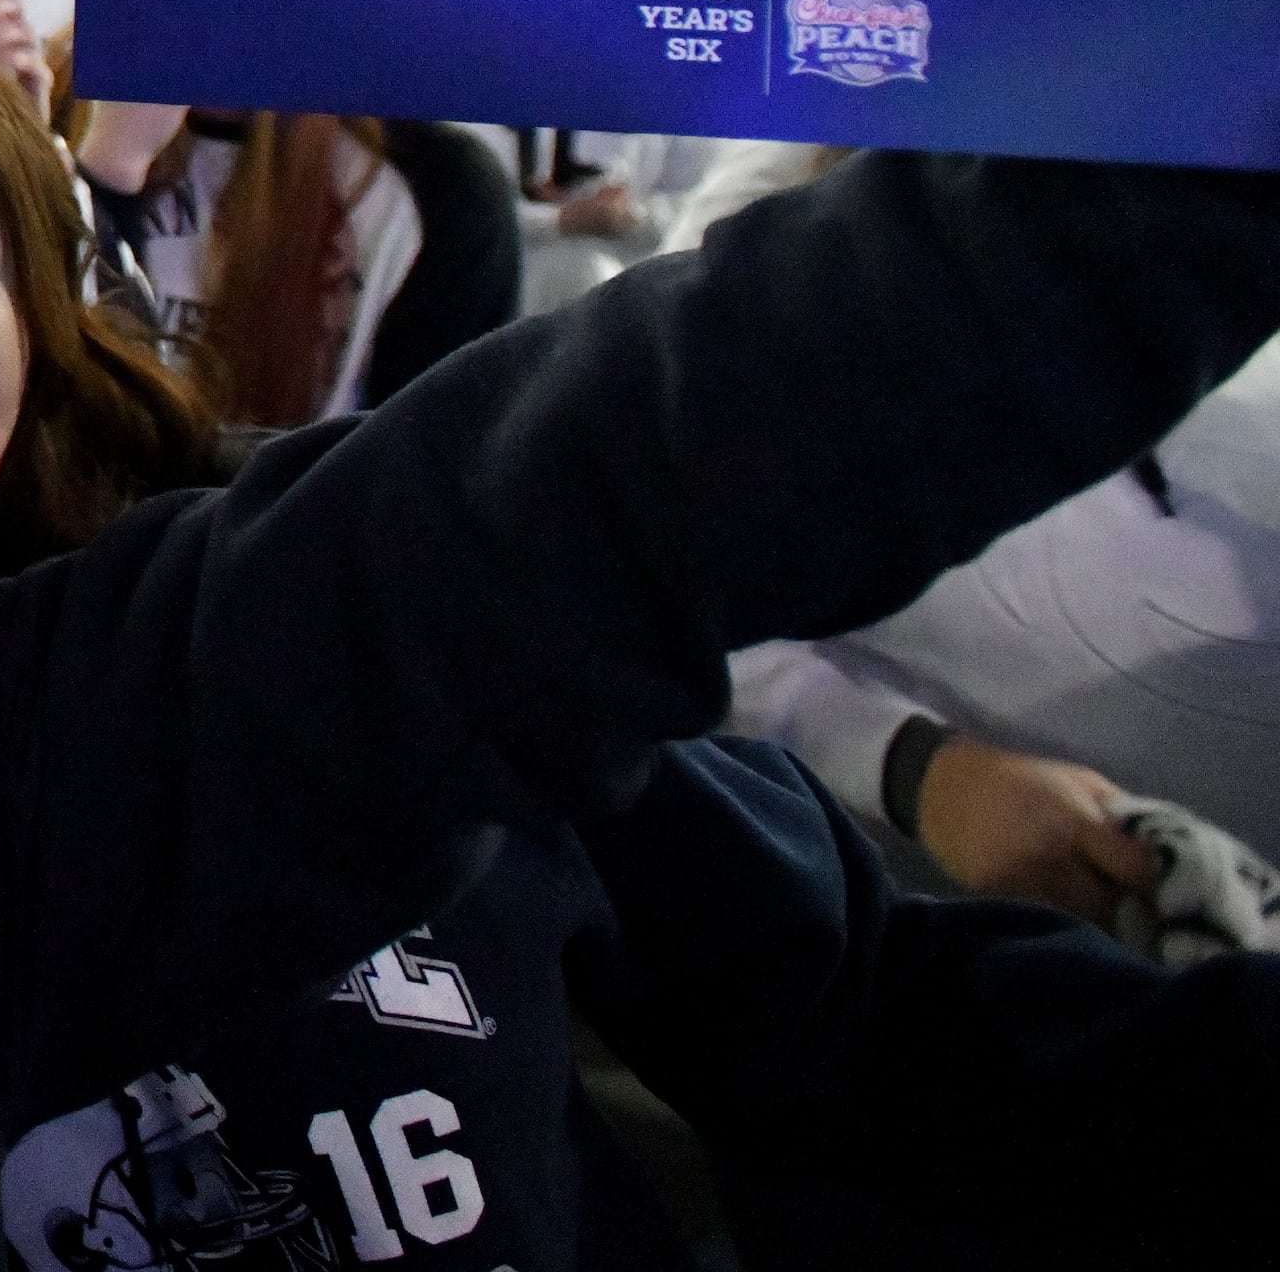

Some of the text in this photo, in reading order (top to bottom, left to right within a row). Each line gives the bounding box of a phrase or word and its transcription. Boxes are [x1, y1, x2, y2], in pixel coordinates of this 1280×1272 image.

[639, 5, 754, 33] YEAR'S
[666, 37, 723, 62] SIX
[797, 27, 919, 56] PEACH
[307, 1089, 485, 1261] 16
